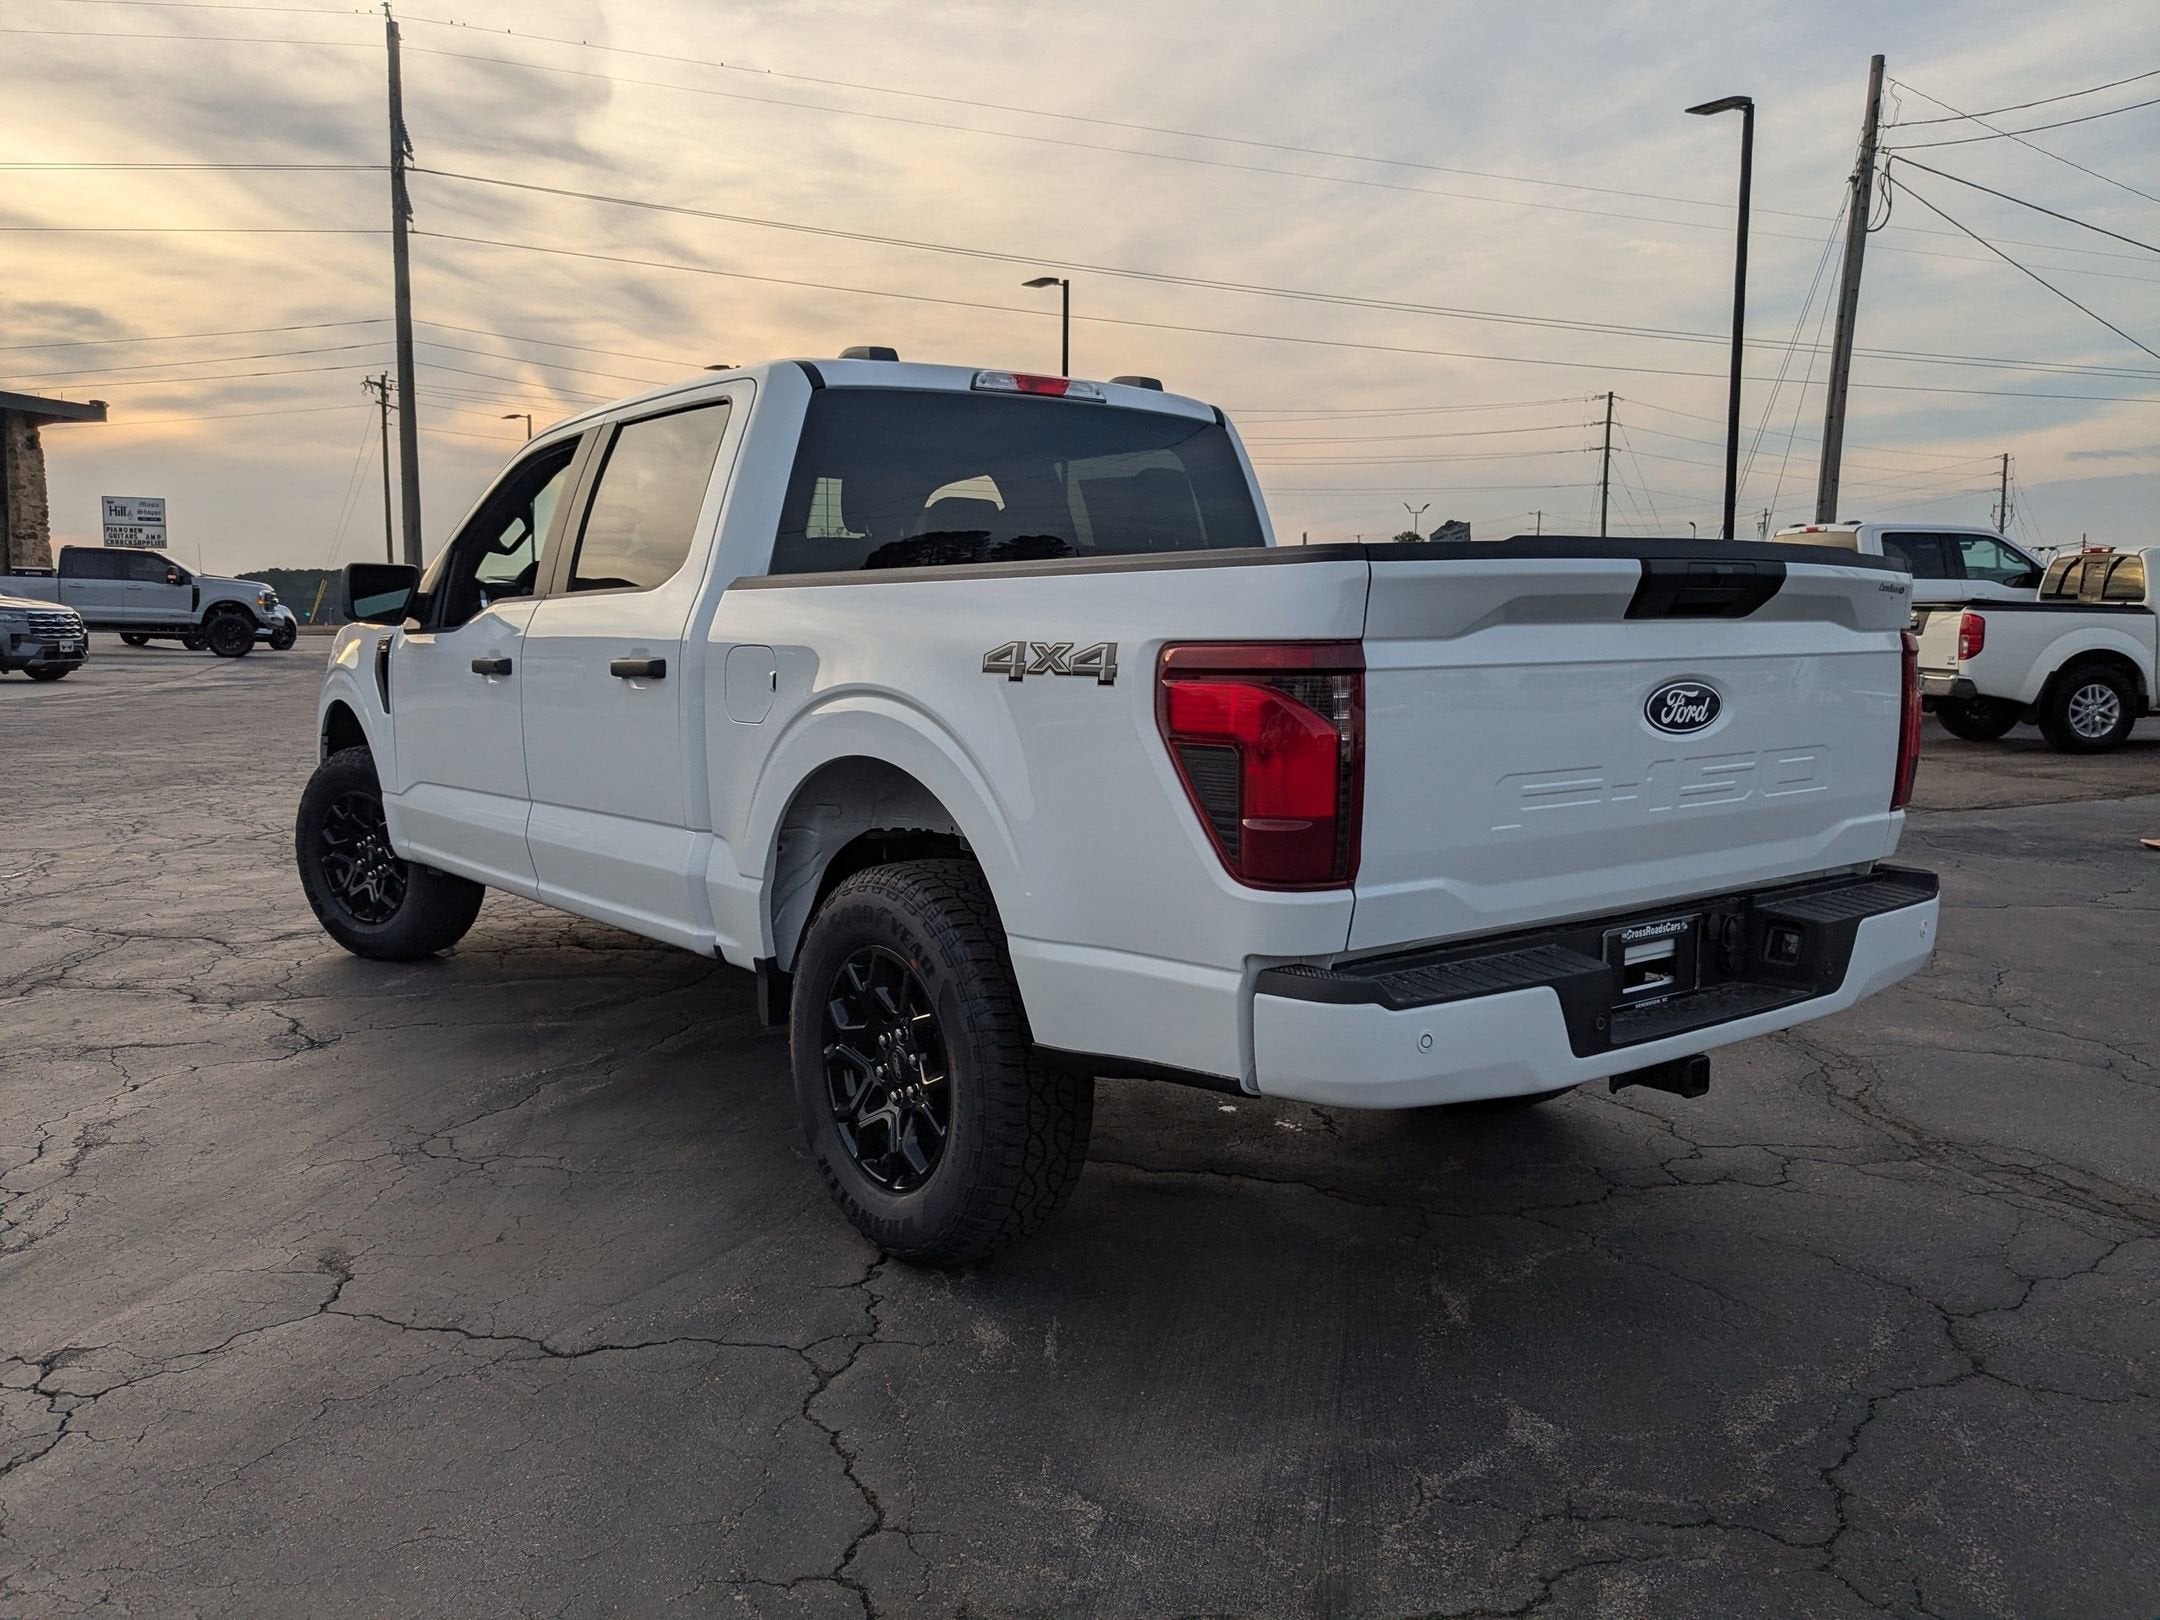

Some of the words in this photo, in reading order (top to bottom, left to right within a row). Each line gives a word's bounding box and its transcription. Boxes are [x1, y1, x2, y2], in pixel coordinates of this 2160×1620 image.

[108, 532, 138, 540] GUITARS
[1660, 688, 1710, 725] Ford
[1491, 743, 1833, 832] F-150
